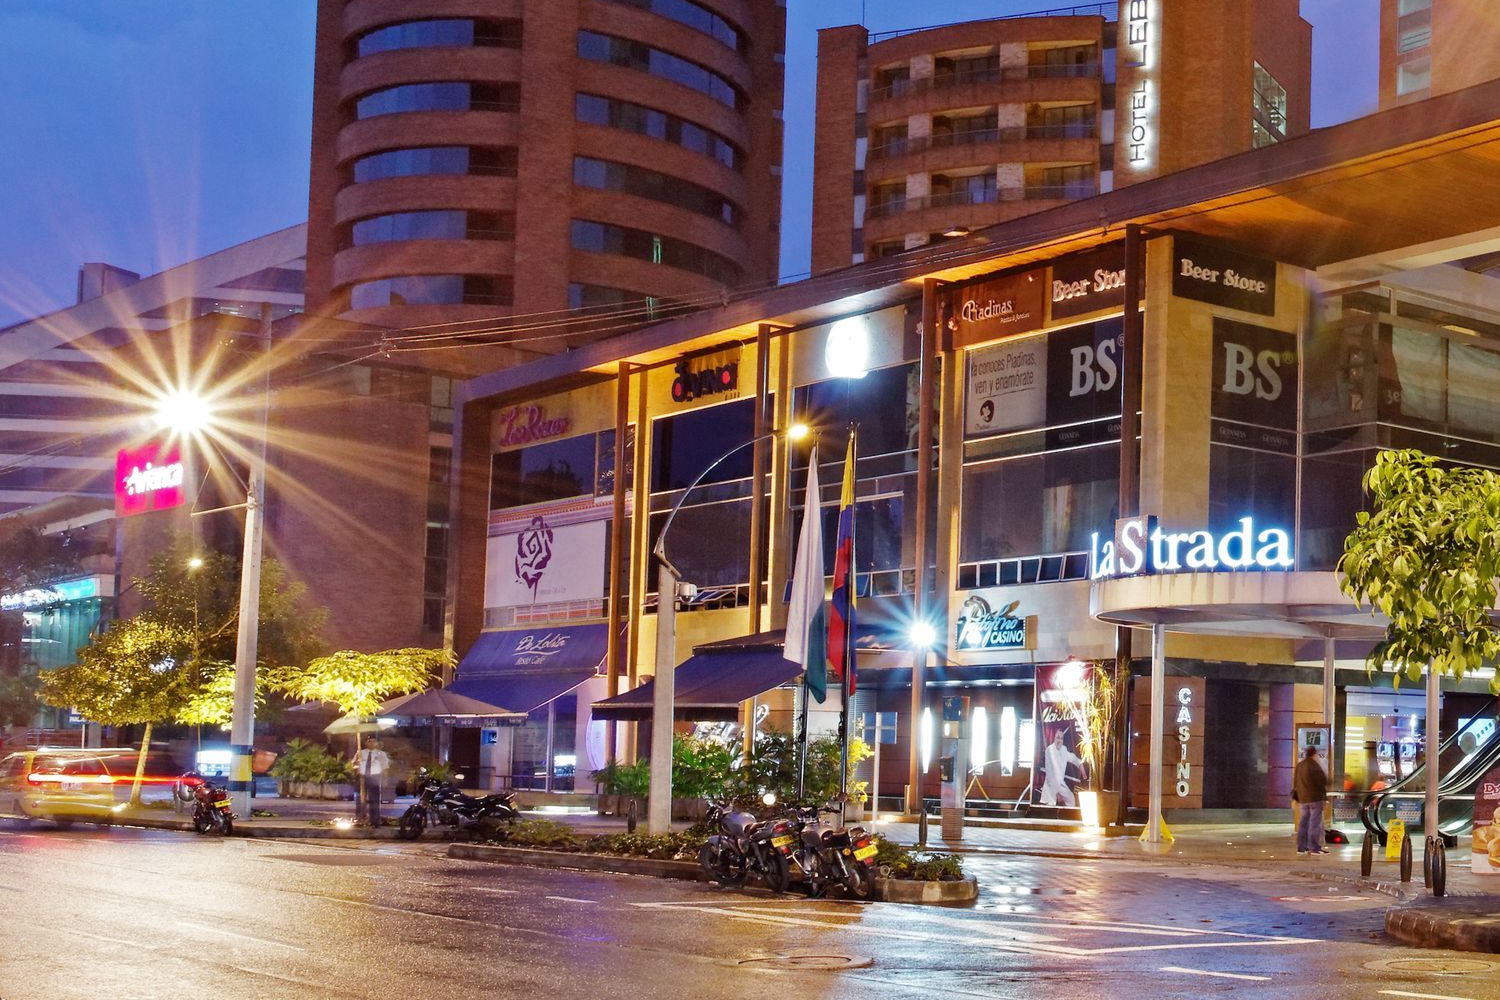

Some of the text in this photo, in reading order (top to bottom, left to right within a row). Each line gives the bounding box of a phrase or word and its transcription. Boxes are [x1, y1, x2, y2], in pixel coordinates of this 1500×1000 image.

[1130, 80, 1146, 162] HOTEL
[1052, 268, 1126, 302] Beer Stor
[1180, 258, 1266, 294] Beer Store
[962, 300, 1013, 323] Piadinas
[978, 358, 1005, 376] conoces
[974, 380, 987, 394] ven
[1120, 517, 1294, 574] Strada
[990, 630, 1023, 644] CASINO
[1176, 687, 1192, 798] CASINO
